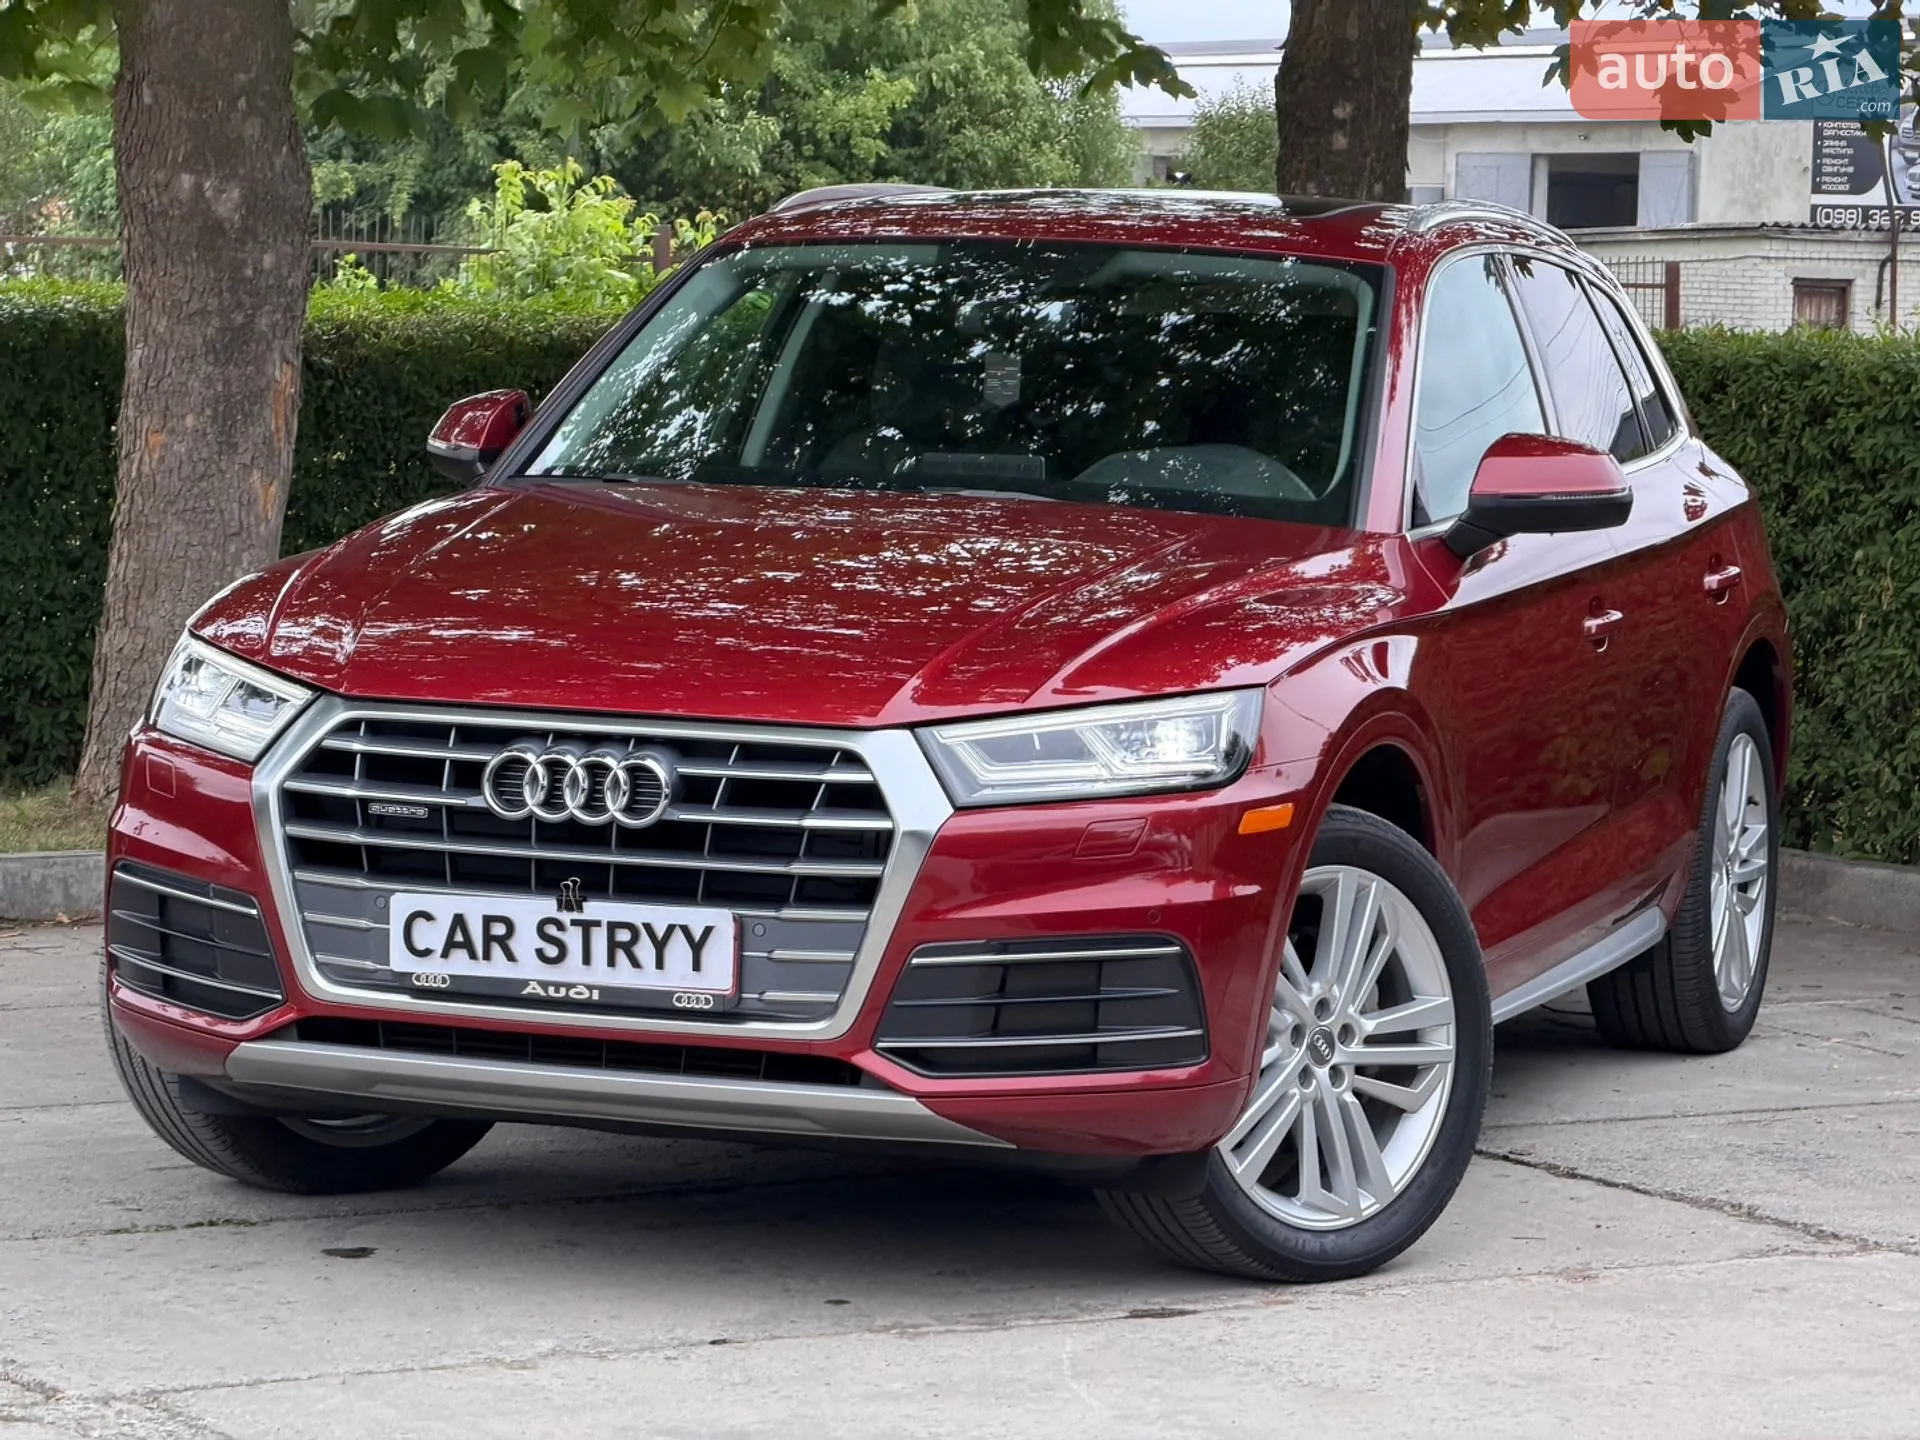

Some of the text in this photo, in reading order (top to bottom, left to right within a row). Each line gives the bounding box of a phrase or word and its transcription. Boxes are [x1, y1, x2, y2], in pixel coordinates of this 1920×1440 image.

[1816, 206, 1862, 225] (098)
[402, 909, 717, 973] CAR STRYY
[519, 981, 600, 1001] Audi
